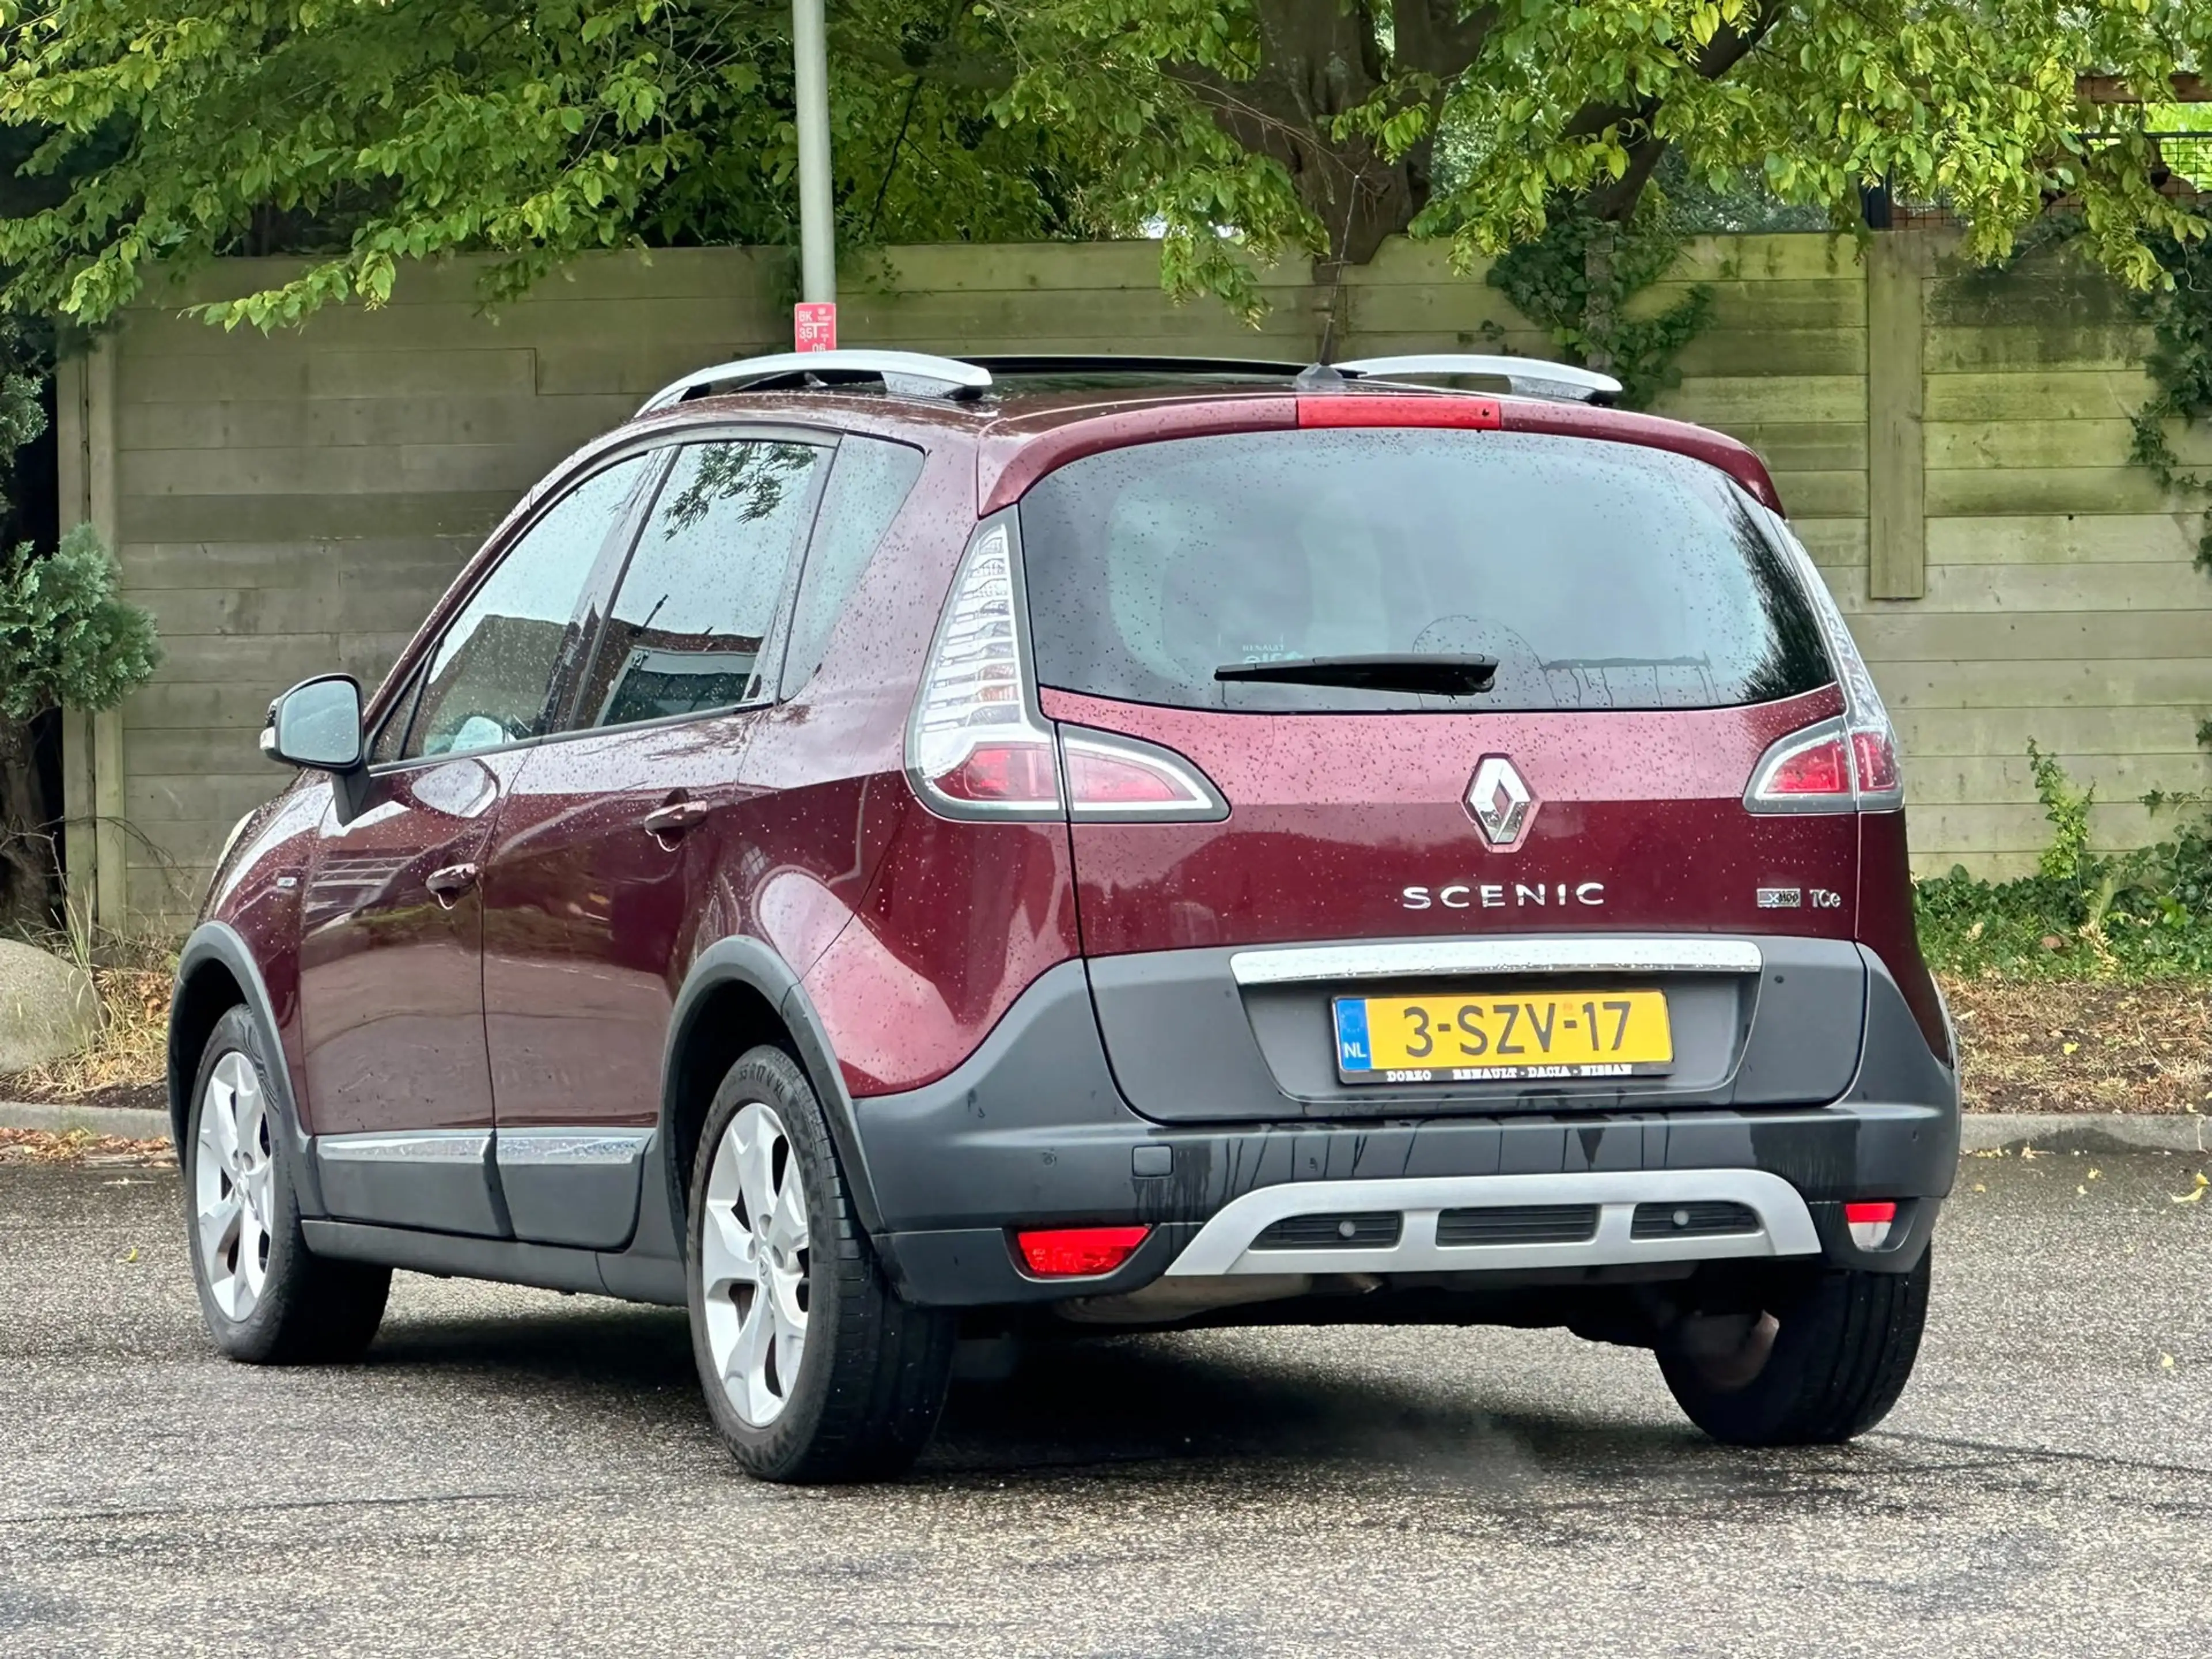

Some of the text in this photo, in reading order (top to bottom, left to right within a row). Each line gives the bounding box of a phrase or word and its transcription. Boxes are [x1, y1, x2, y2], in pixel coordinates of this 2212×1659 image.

[798, 310, 812, 321] BK
[1403, 882, 1604, 909] SCENIC
[1809, 889, 1842, 908] TCe
[1403, 1001, 1631, 1058] 3-SZV-17
[1344, 1041, 1367, 1059] NL
[1452, 1067, 1517, 1080] RENAULT
[1527, 1066, 1571, 1078] DACIA
